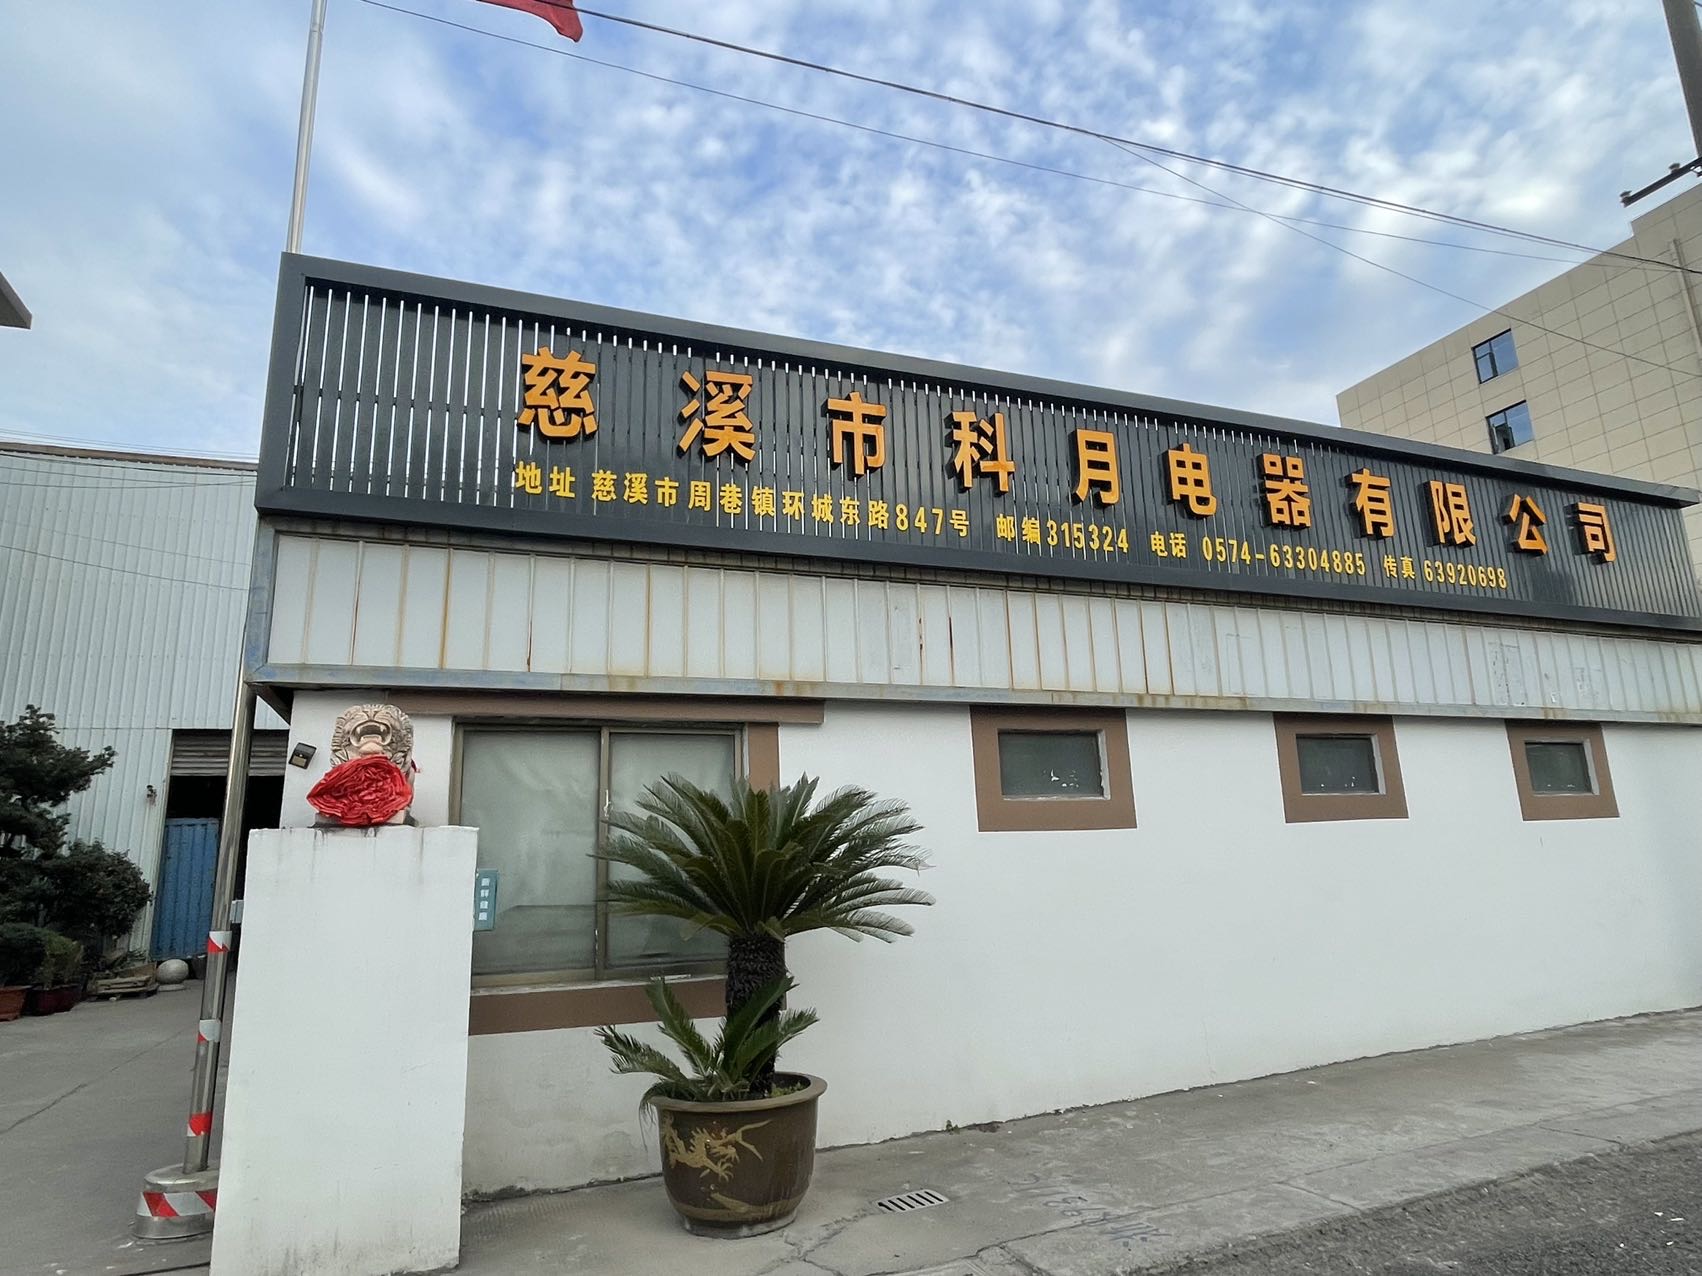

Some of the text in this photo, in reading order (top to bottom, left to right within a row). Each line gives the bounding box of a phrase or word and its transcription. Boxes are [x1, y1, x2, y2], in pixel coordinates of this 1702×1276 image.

[515, 461, 575, 498] 地址
[1150, 531, 1188, 559] 电话
[1202, 536, 1366, 576] 0574-63304885
[1383, 555, 1416, 579] 传真
[1423, 563, 1508, 589] 63920698
[517, 346, 1616, 563] 慈溪市科月电器有限公司
